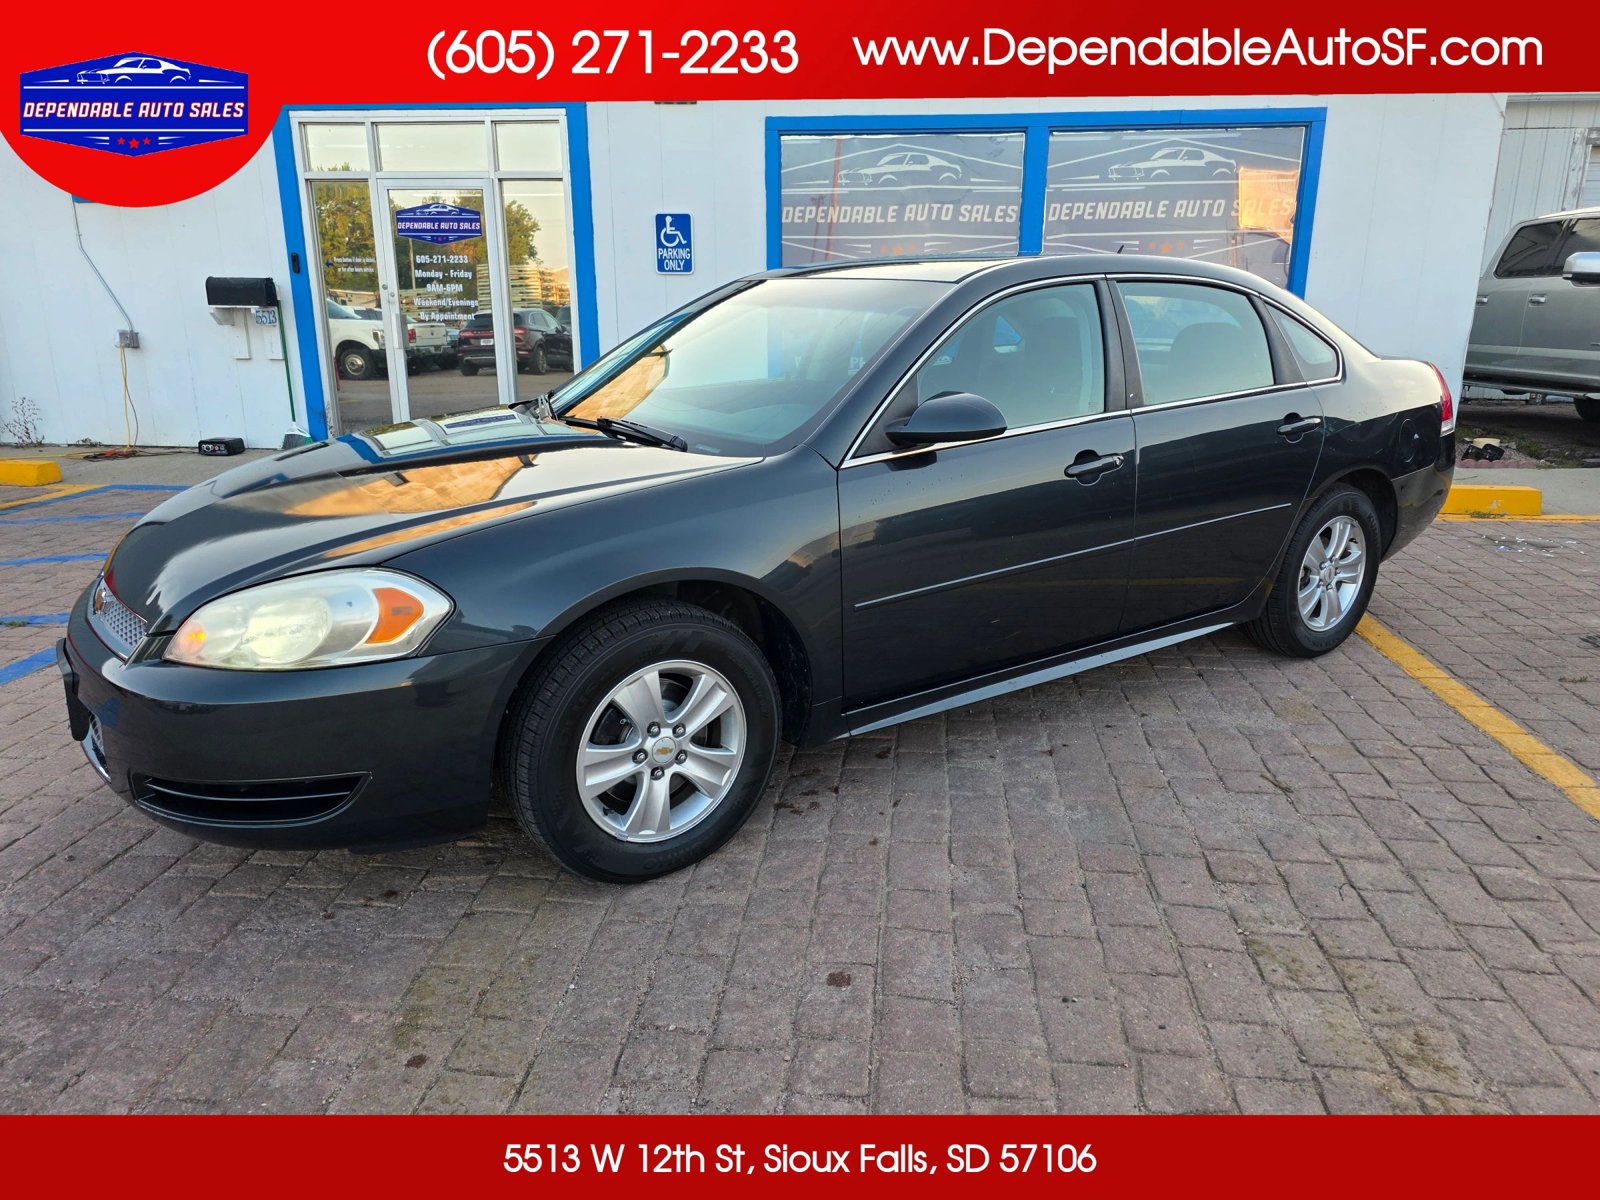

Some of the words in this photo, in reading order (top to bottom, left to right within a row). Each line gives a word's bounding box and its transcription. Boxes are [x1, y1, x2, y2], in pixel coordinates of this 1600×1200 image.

[782, 205, 898, 223] DEPENDABLE
[904, 203, 954, 221] AUTO
[959, 204, 1019, 223] SALES
[1048, 200, 1169, 221] DEPENDABLE
[1173, 199, 1226, 218] AUTO
[1231, 198, 1293, 217] SALES
[397, 222, 439, 230] DEPENDABLE
[440, 222, 458, 230] AUTO
[459, 222, 481, 230] SALES
[415, 255, 469, 264] 605-271-2233
[658, 248, 691, 260] PARKING
[664, 259, 685, 271] ONLY
[414, 270, 443, 279] Monday
[449, 270, 473, 280] Friday
[255, 309, 277, 325] 5513
